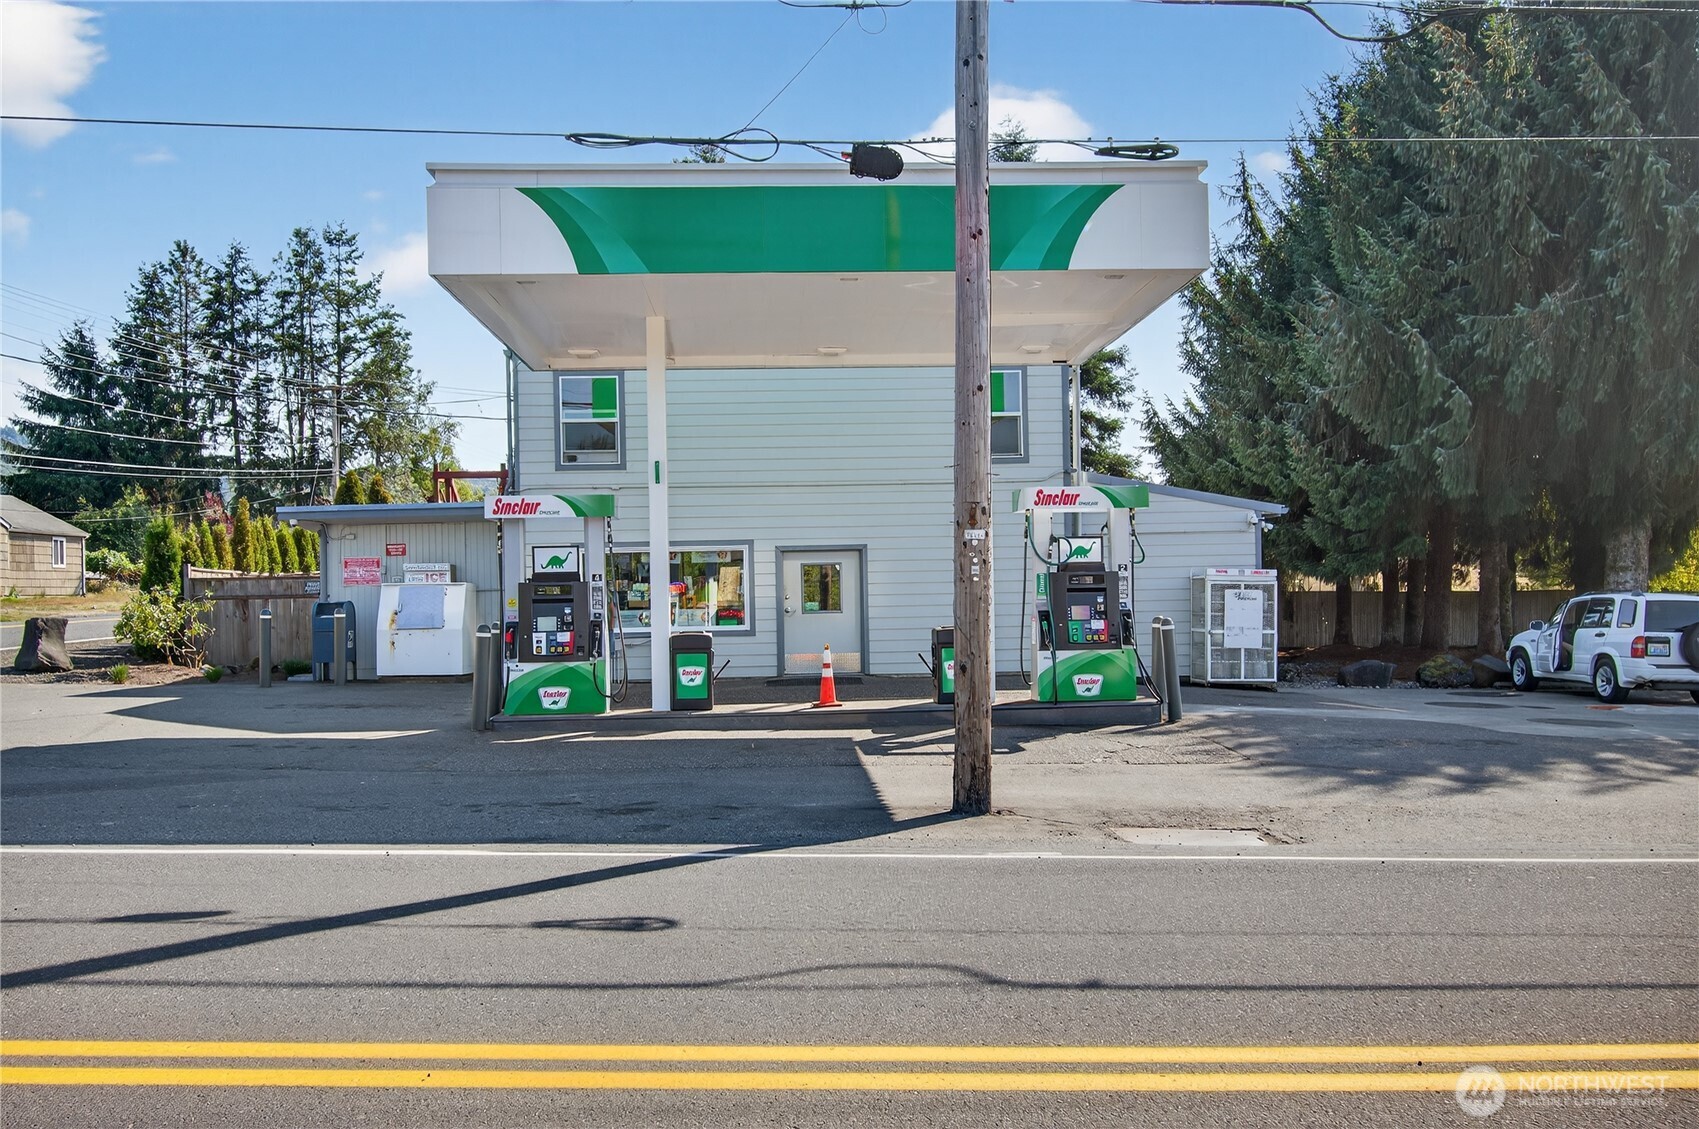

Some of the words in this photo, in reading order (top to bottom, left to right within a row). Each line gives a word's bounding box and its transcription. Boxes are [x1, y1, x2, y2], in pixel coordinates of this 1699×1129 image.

[492, 497, 541, 515] Sinclair
[1034, 488, 1080, 506] Sinclair
[425, 573, 448, 582] ICE
